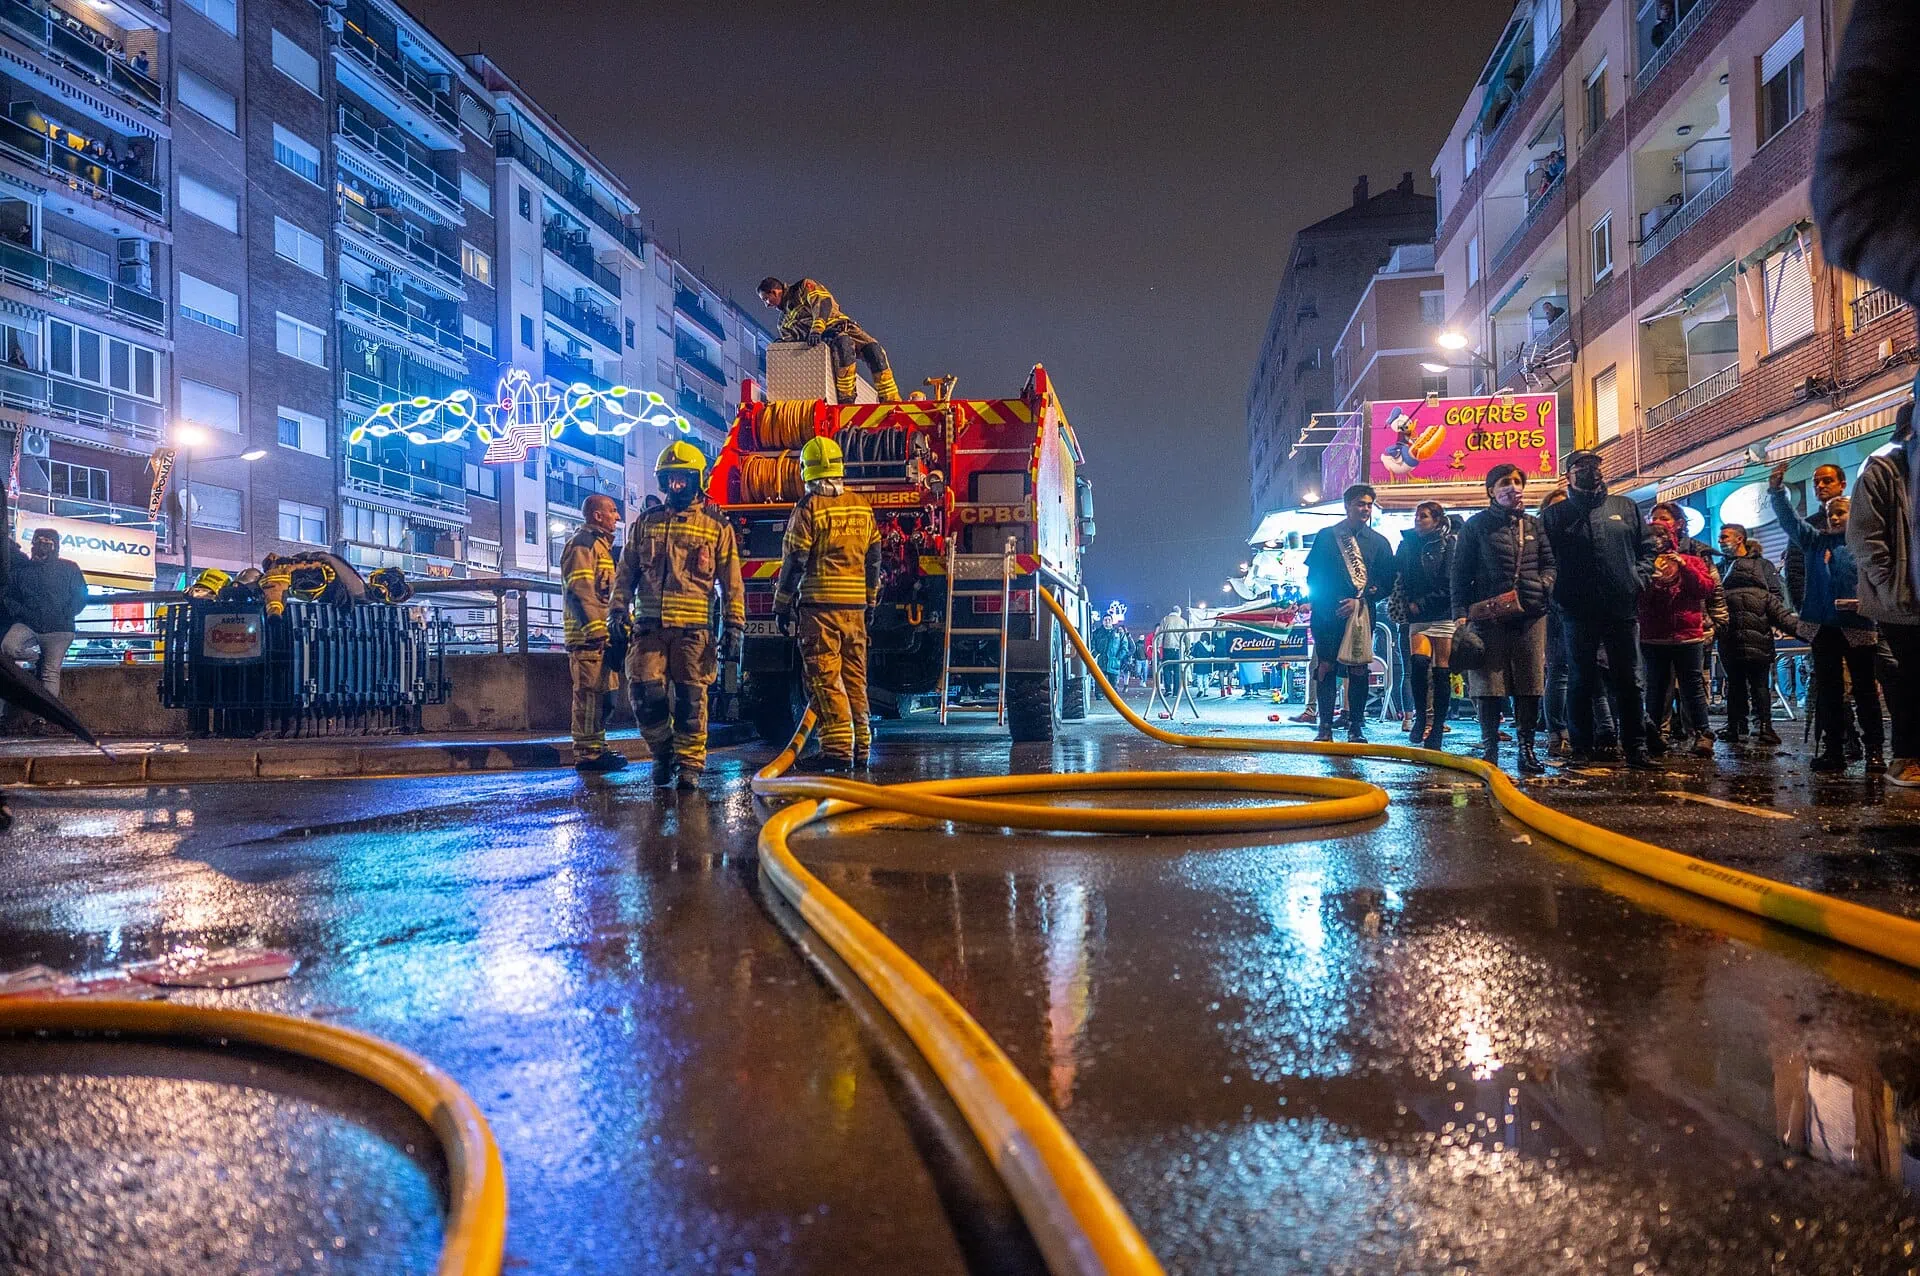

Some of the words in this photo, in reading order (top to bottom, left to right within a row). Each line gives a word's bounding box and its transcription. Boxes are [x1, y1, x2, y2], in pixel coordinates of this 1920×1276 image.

[1445, 402, 1528, 425] GOFRES
[1465, 429, 1547, 451] CREPES
[867, 491, 920, 504] MBERS
[59, 533, 152, 557] APONAZO
[743, 622, 765, 634] 226
